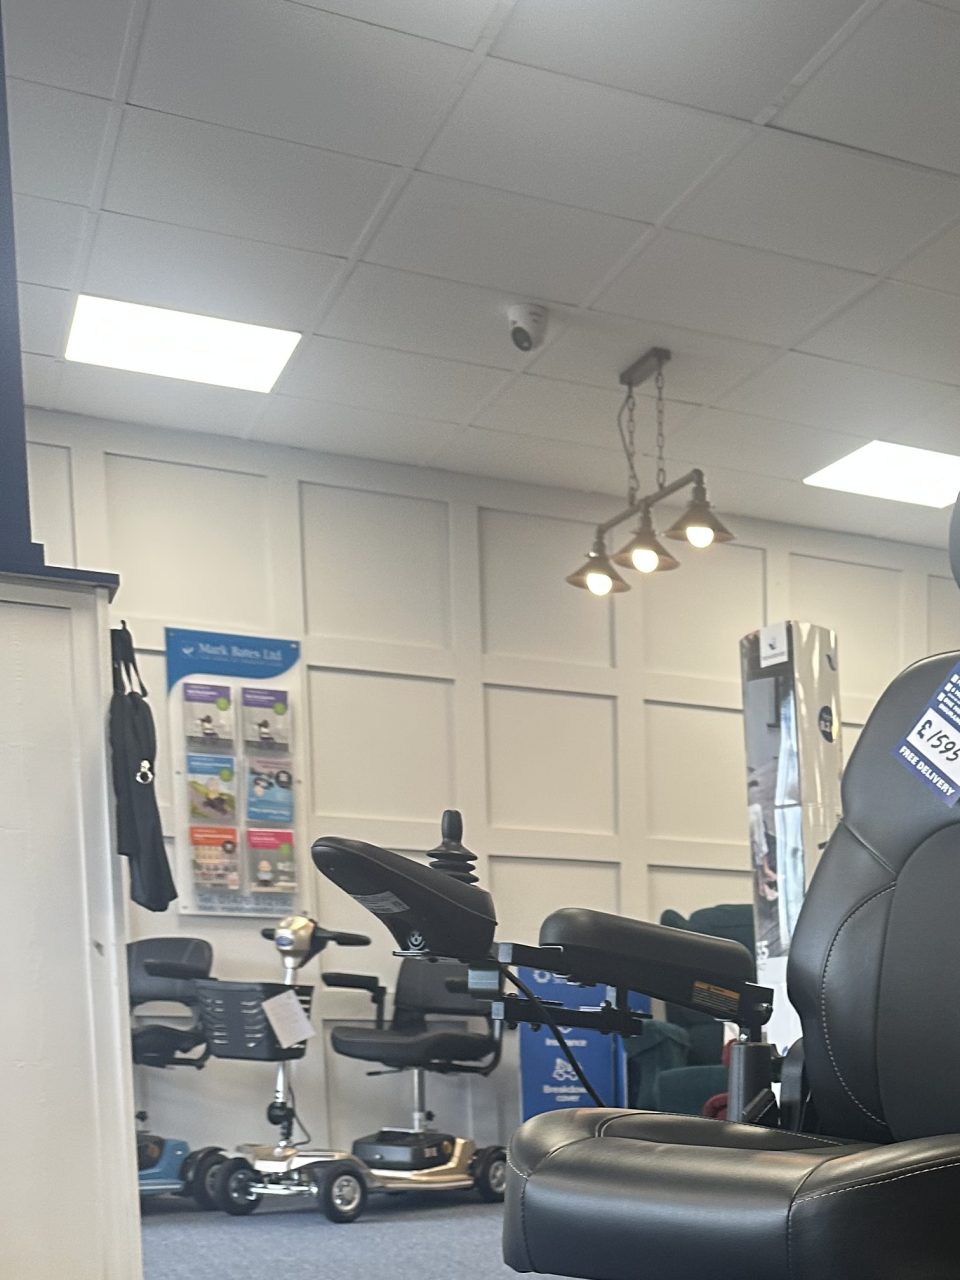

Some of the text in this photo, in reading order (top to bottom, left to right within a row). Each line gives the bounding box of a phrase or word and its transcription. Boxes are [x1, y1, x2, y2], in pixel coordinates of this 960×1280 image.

[198, 643, 228, 656] Mark
[231, 646, 261, 660] Bates
[263, 649, 282, 661] Ltd
[899, 746, 956, 797] FREE DELIVERY
[543, 1084, 589, 1094] Breakdow
